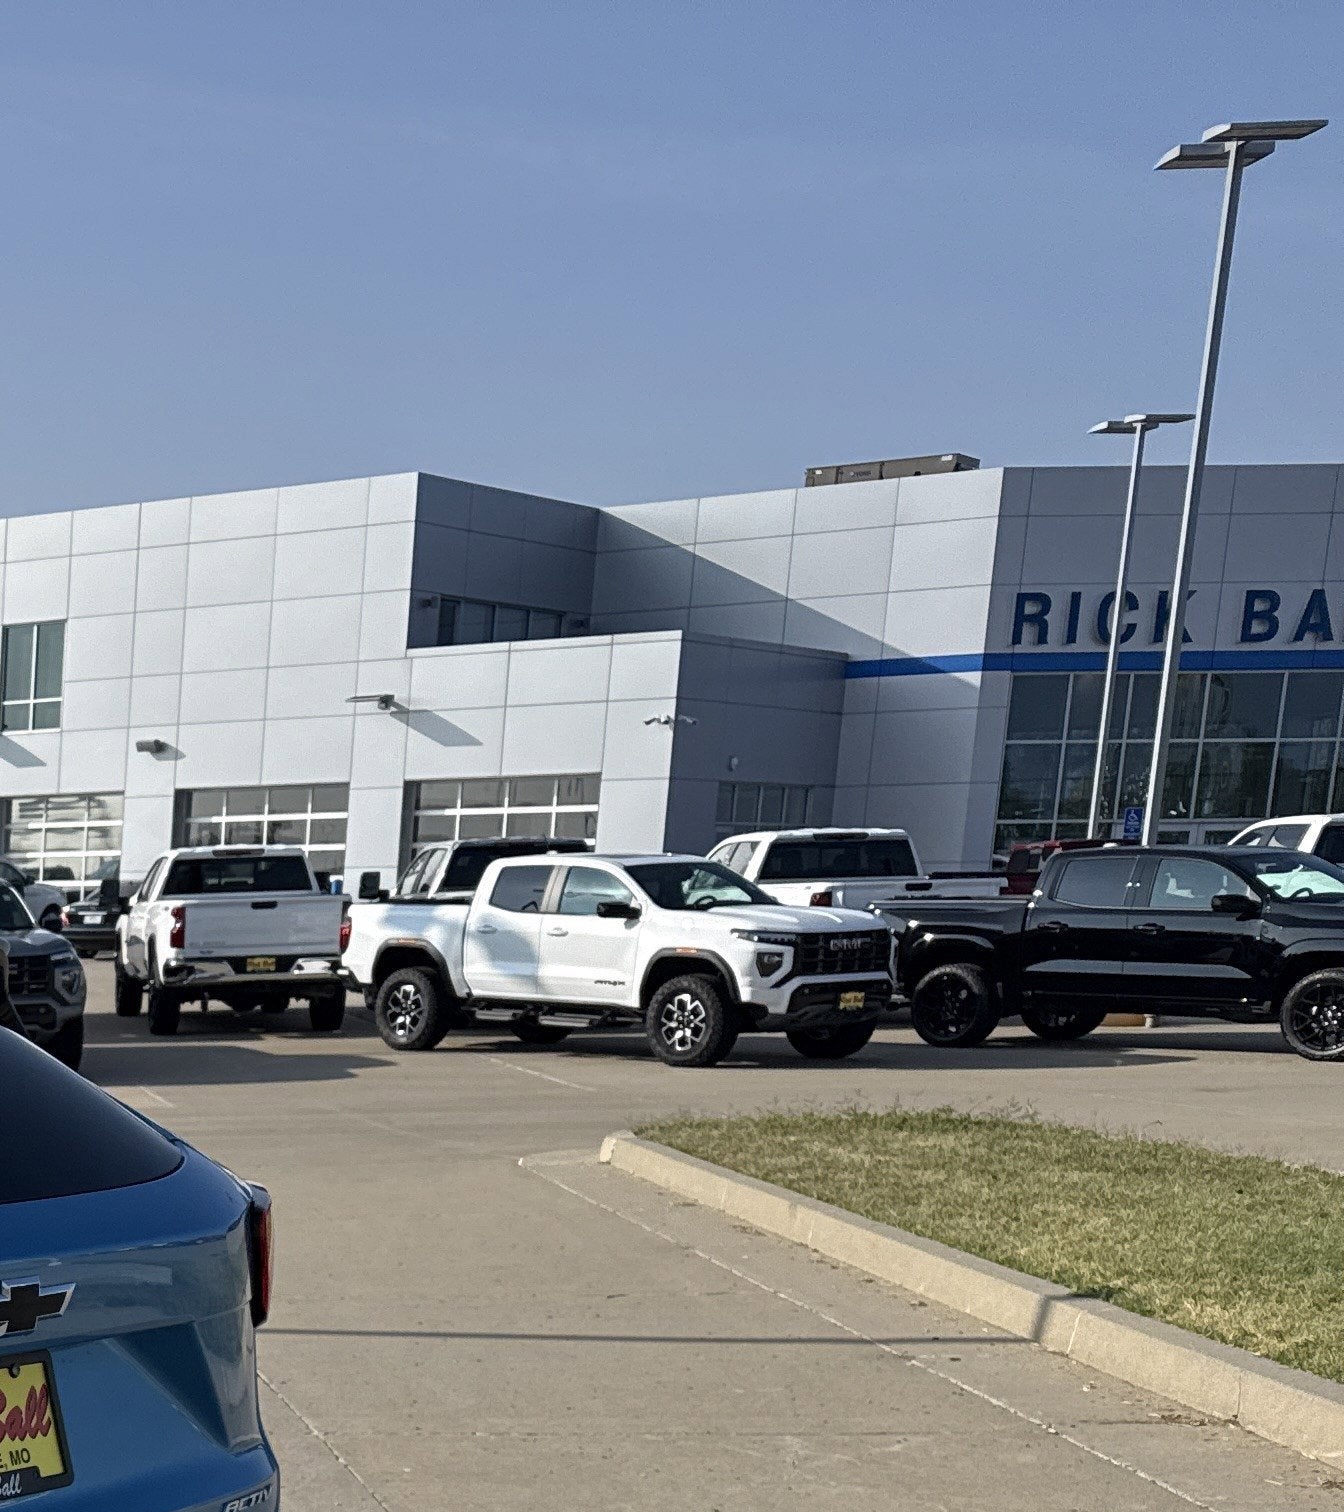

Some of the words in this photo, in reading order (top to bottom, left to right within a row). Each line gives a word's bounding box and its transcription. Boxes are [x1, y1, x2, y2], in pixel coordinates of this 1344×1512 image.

[1011, 590, 1197, 645] RICK
[1238, 588, 1344, 642] BA
[11, 1448, 31, 1466] MO
